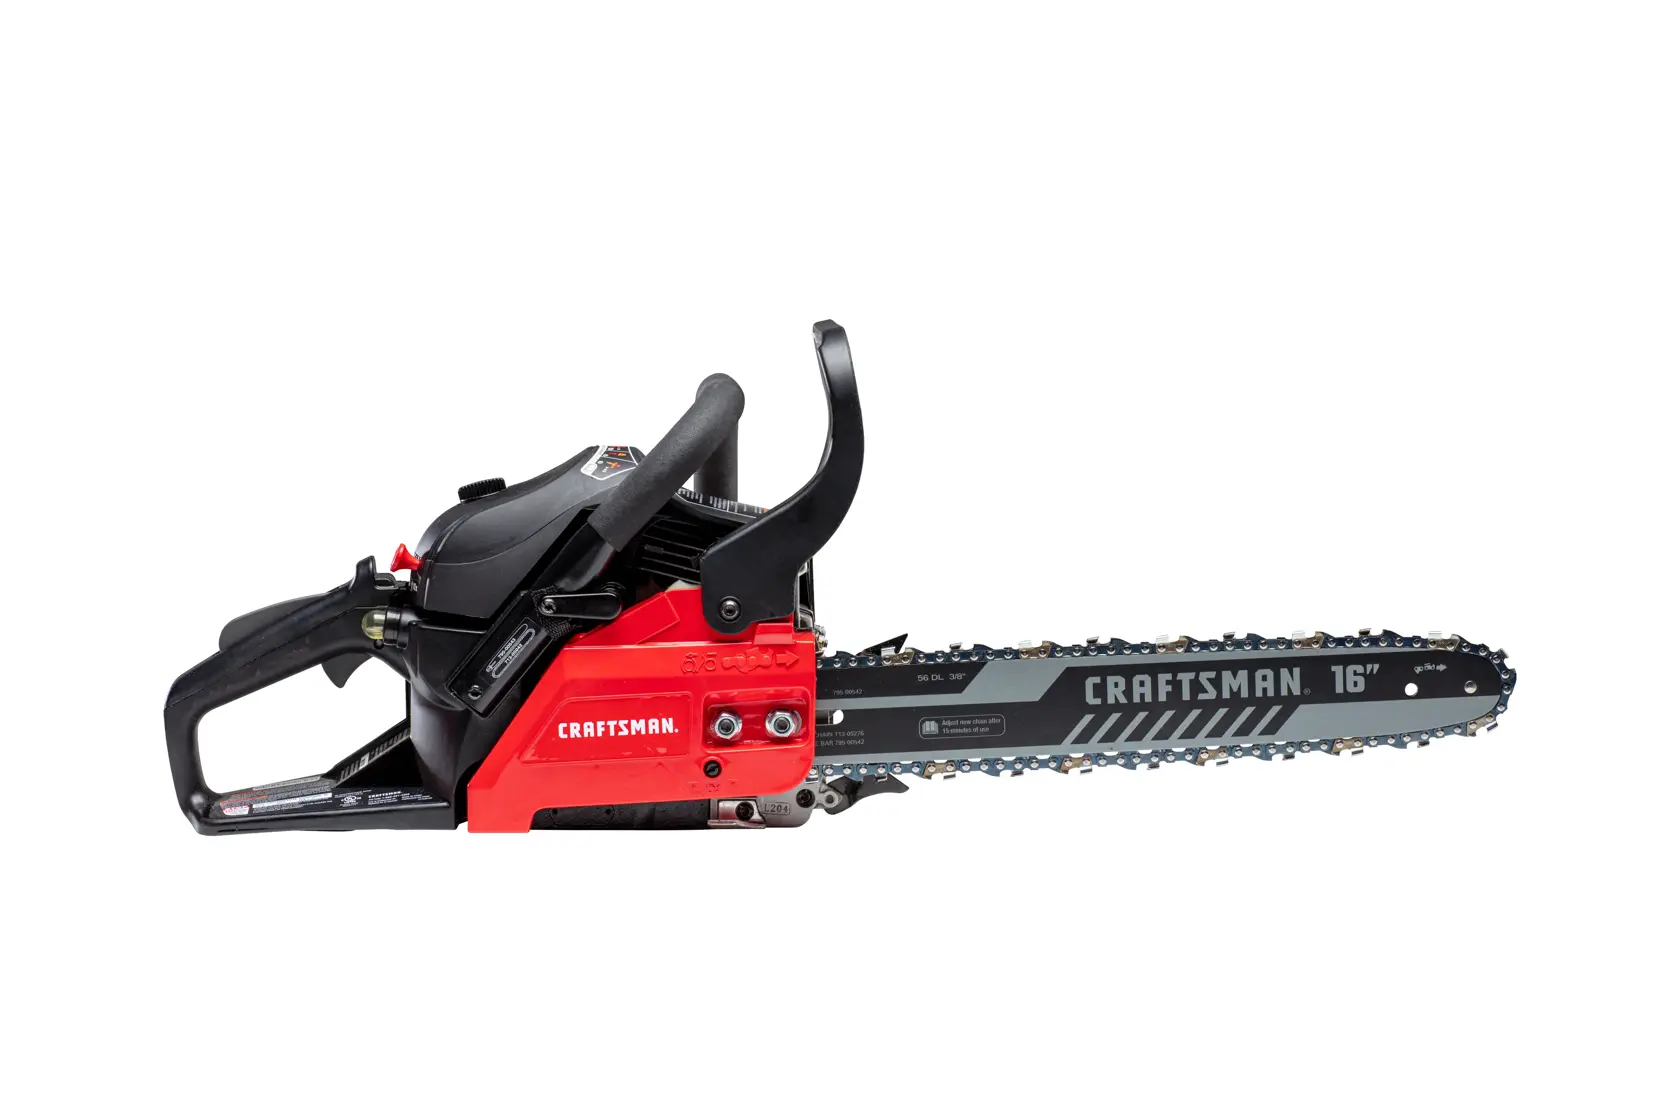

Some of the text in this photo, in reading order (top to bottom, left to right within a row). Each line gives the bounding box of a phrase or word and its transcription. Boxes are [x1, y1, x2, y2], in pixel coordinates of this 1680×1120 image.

[917, 674, 929, 682] 56
[931, 673, 945, 681] DL
[1331, 663, 1380, 694] 16"
[941, 719, 959, 727] Adjust
[972, 717, 988, 725] chain
